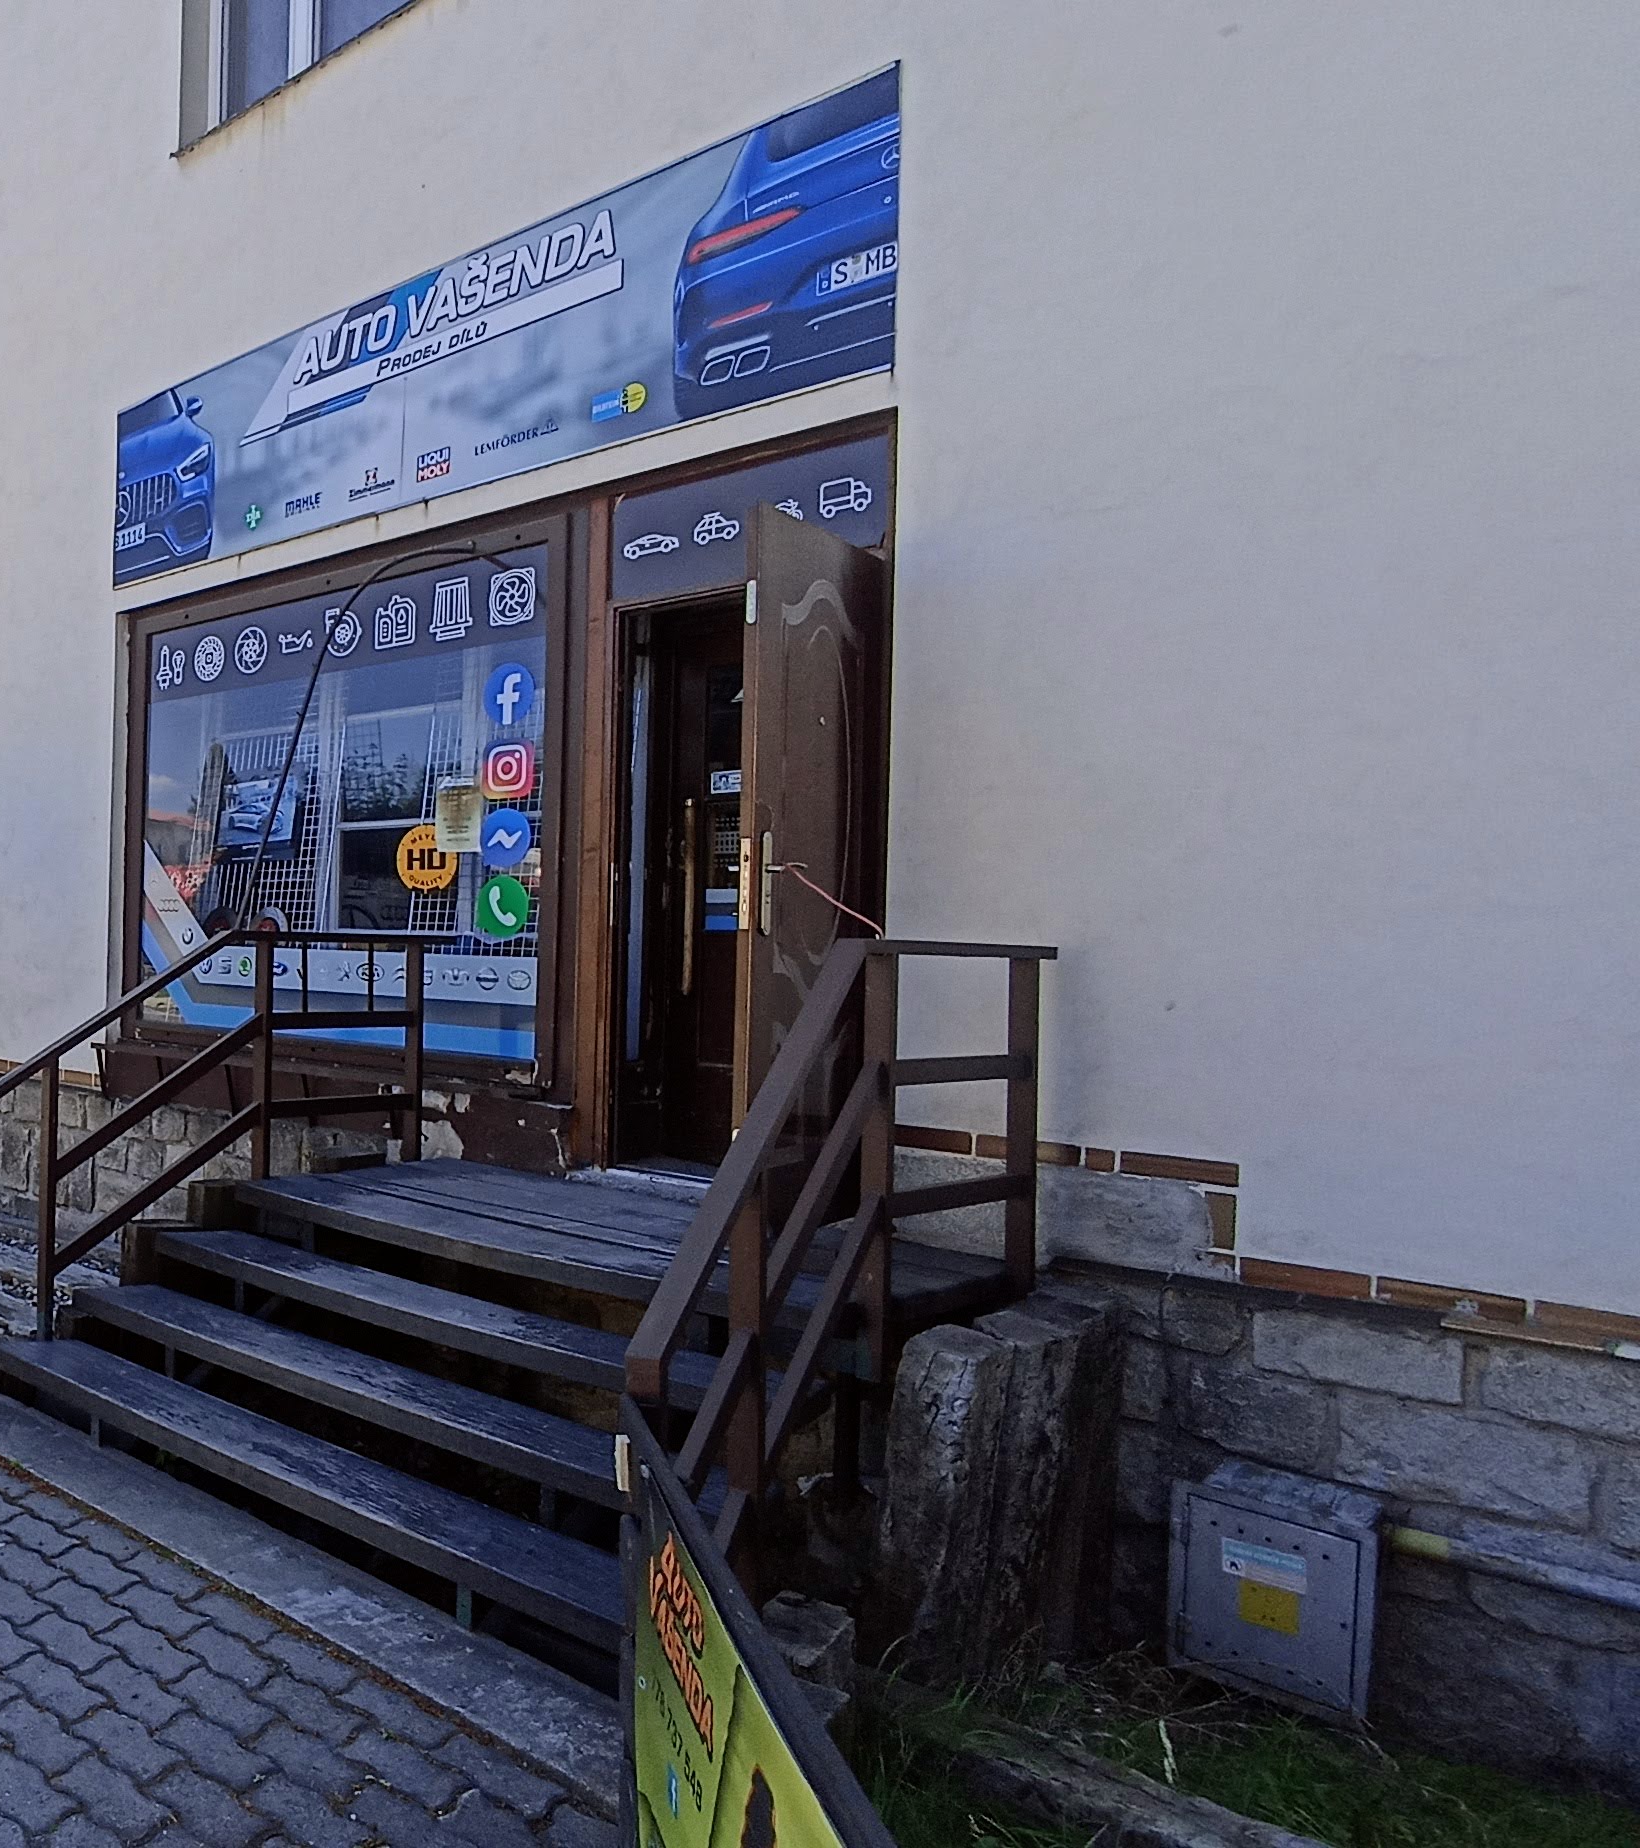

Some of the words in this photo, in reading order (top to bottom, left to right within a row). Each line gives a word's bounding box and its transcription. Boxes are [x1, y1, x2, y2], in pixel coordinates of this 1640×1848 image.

[864, 244, 897, 275] MB
[293, 304, 397, 385] AUTO
[408, 209, 616, 338] VAŠENDA
[376, 341, 442, 377] PRODEJ
[448, 321, 488, 351] DÍLŮ
[474, 427, 539, 456] LEMFÖRDER
[418, 448, 450, 468] LIQUI
[417, 463, 450, 482] MOLY
[285, 493, 321, 514] MAHLE
[410, 834, 436, 845] MEYL
[406, 848, 447, 871] HD
[408, 874, 443, 887] QUALITY
[683, 1750, 703, 1813] 548
